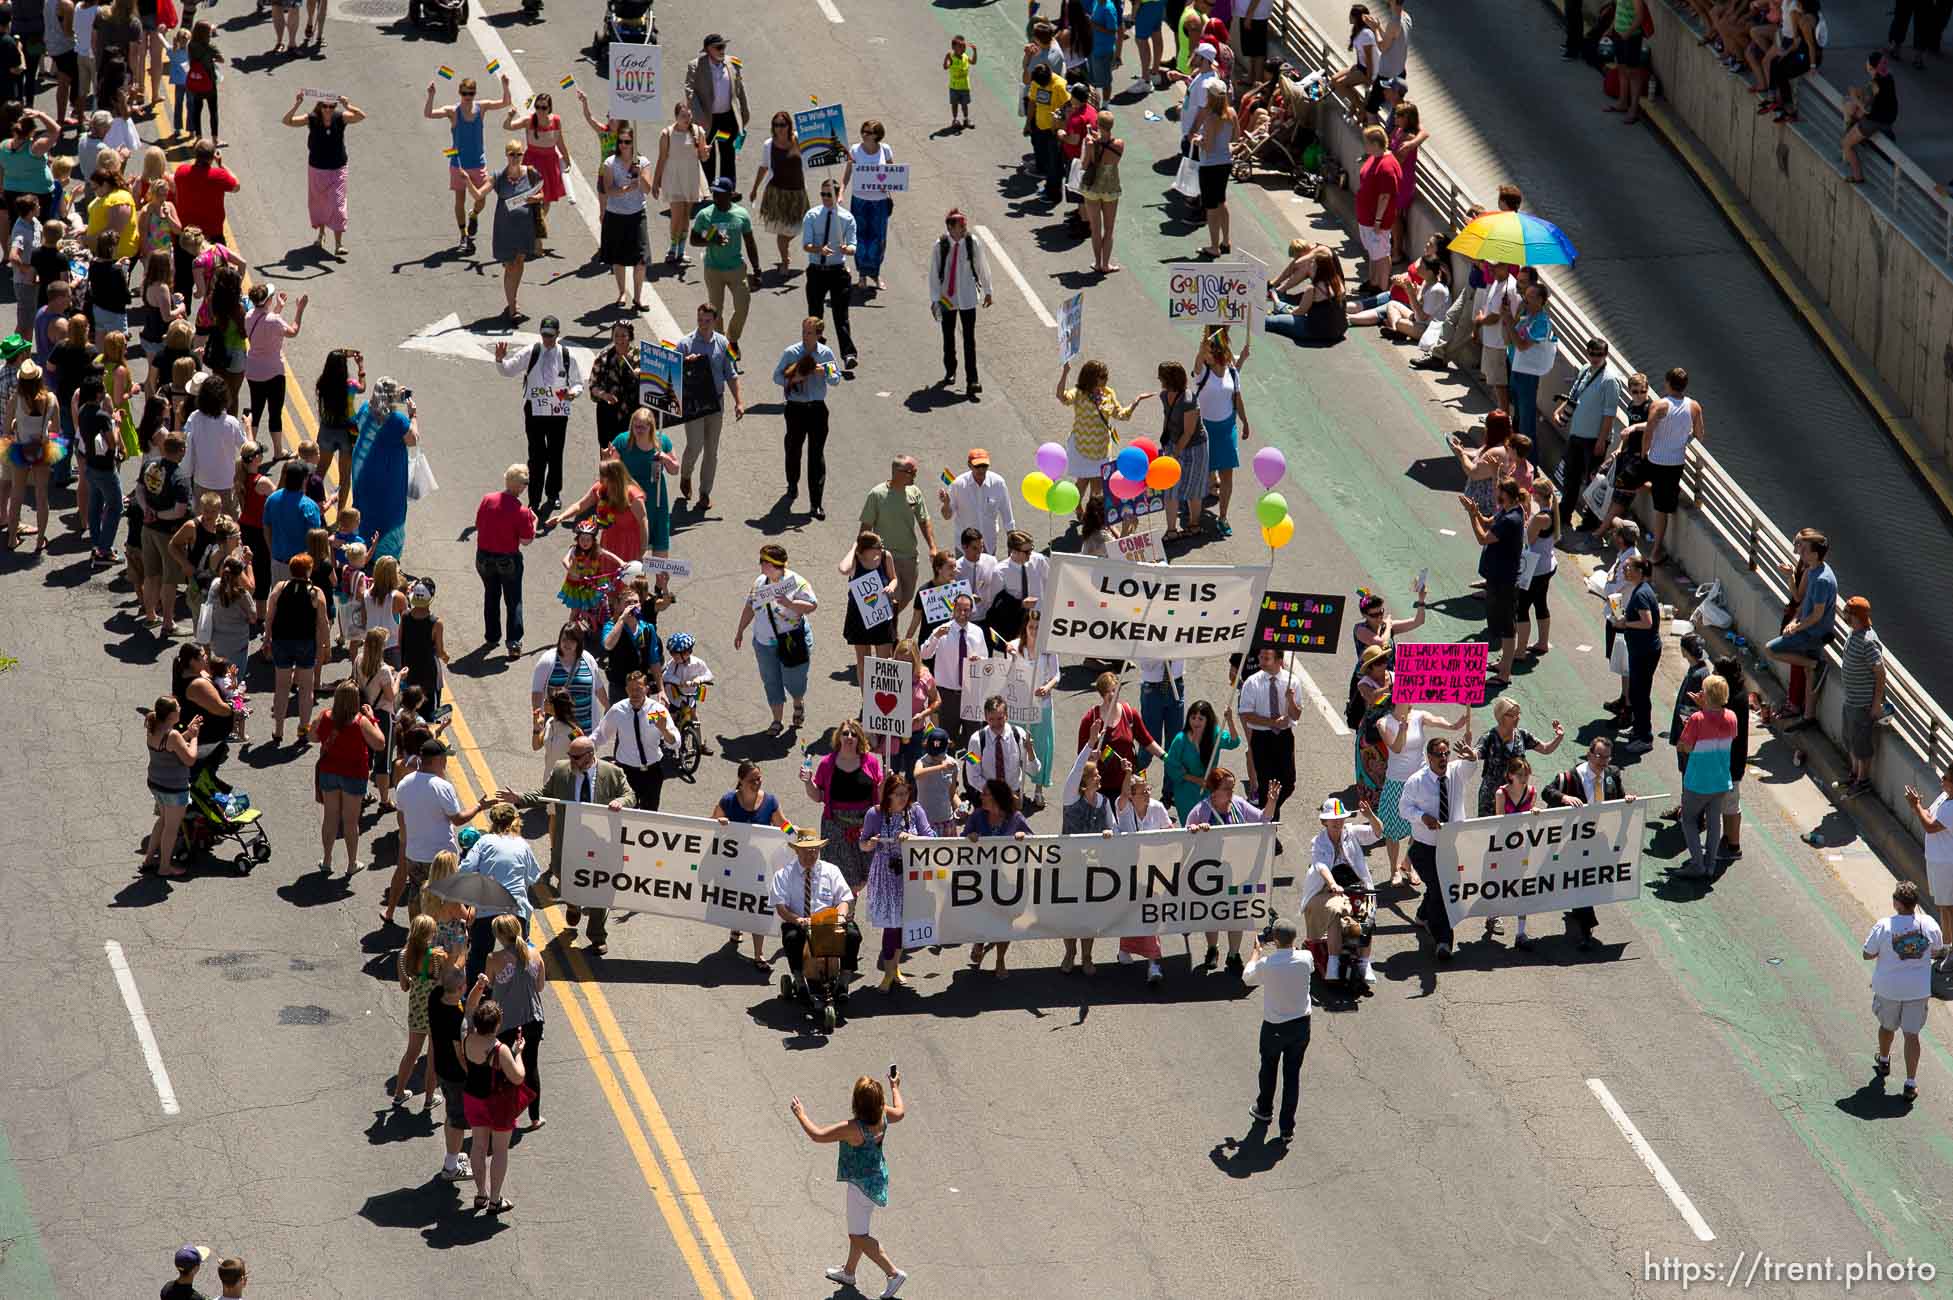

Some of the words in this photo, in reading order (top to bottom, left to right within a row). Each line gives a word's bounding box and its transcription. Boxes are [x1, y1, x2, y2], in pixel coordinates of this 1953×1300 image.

[621, 54, 651, 70] God
[615, 70, 656, 93] LOVE
[855, 164, 880, 172] JESUS
[884, 165, 905, 173] SAID
[861, 183, 904, 191] EVERYONE
[1170, 274, 1199, 294] God
[1218, 276, 1247, 295] Love
[1169, 298, 1198, 318] Love
[531, 386, 553, 398] god
[1119, 533, 1152, 553] COME
[649, 561, 685, 572] BUILDING
[857, 577, 879, 597] LDS
[1100, 576, 1181, 602] LOVE
[1190, 583, 1217, 602] IS
[865, 606, 890, 626] LGBT
[1051, 618, 1168, 643] SPOKEN
[1174, 622, 1248, 644] HERE
[875, 661, 899, 678] PARK
[1441, 659, 1461, 672] WITH
[870, 675, 904, 693] FAMILY
[1397, 688, 1415, 701] MY
[869, 715, 905, 735] LGBTQI
[620, 826, 702, 854] LOVE
[711, 837, 739, 858] IS
[1488, 825, 1563, 852] LOVE
[1571, 821, 1596, 841] IS
[909, 845, 1062, 867] MORMONS
[573, 868, 692, 903] SPOKEN
[701, 883, 775, 916] HERE
[951, 859, 1226, 907] BUILDING
[1448, 873, 1555, 904] SPOKEN
[1562, 862, 1632, 889] HERE
[1141, 899, 1266, 925] BRIDGES
[909, 926, 933, 942] 110
